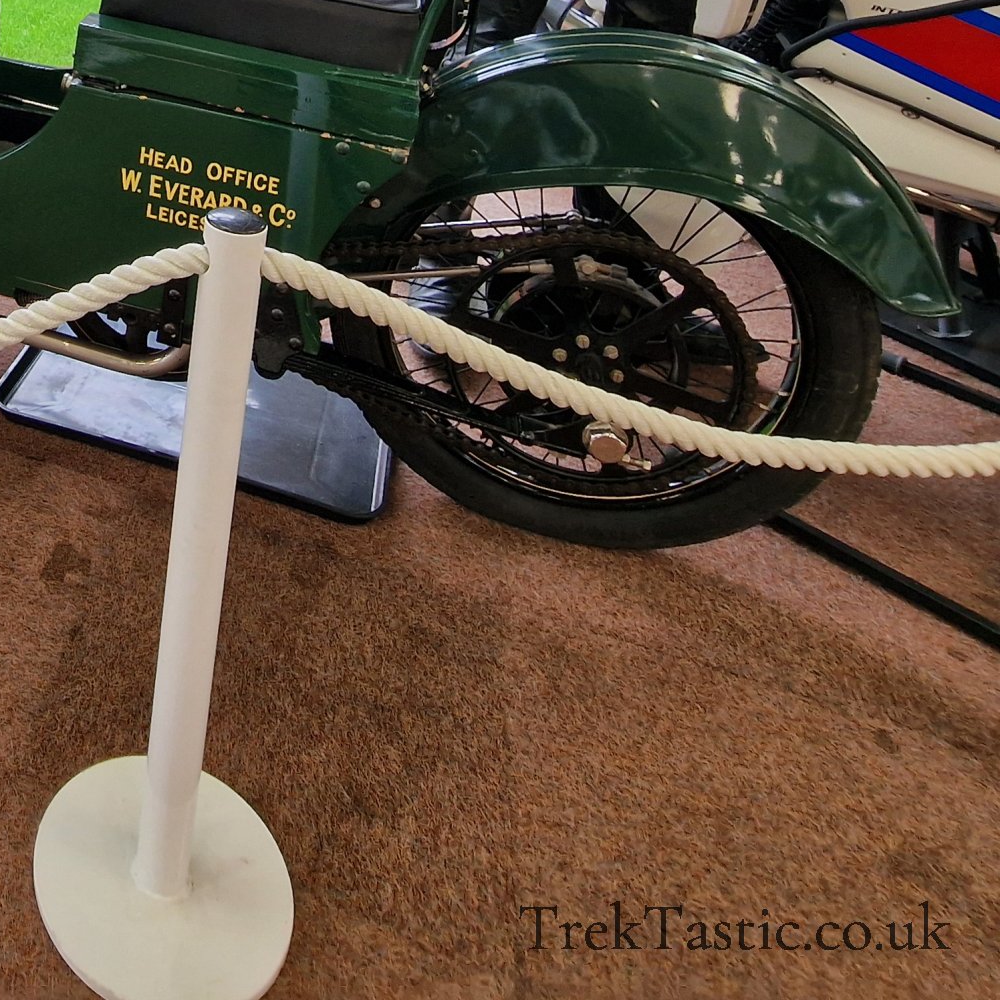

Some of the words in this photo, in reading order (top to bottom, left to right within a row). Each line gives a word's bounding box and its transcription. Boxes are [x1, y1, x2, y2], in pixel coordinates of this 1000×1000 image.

[871, 5, 903, 15] INT
[121, 167, 143, 194] W.
[148, 174, 248, 210] EVERARD
[139, 146, 193, 175] HEAD
[206, 162, 281, 195] OFFICE
[146, 203, 206, 232] LEICES
